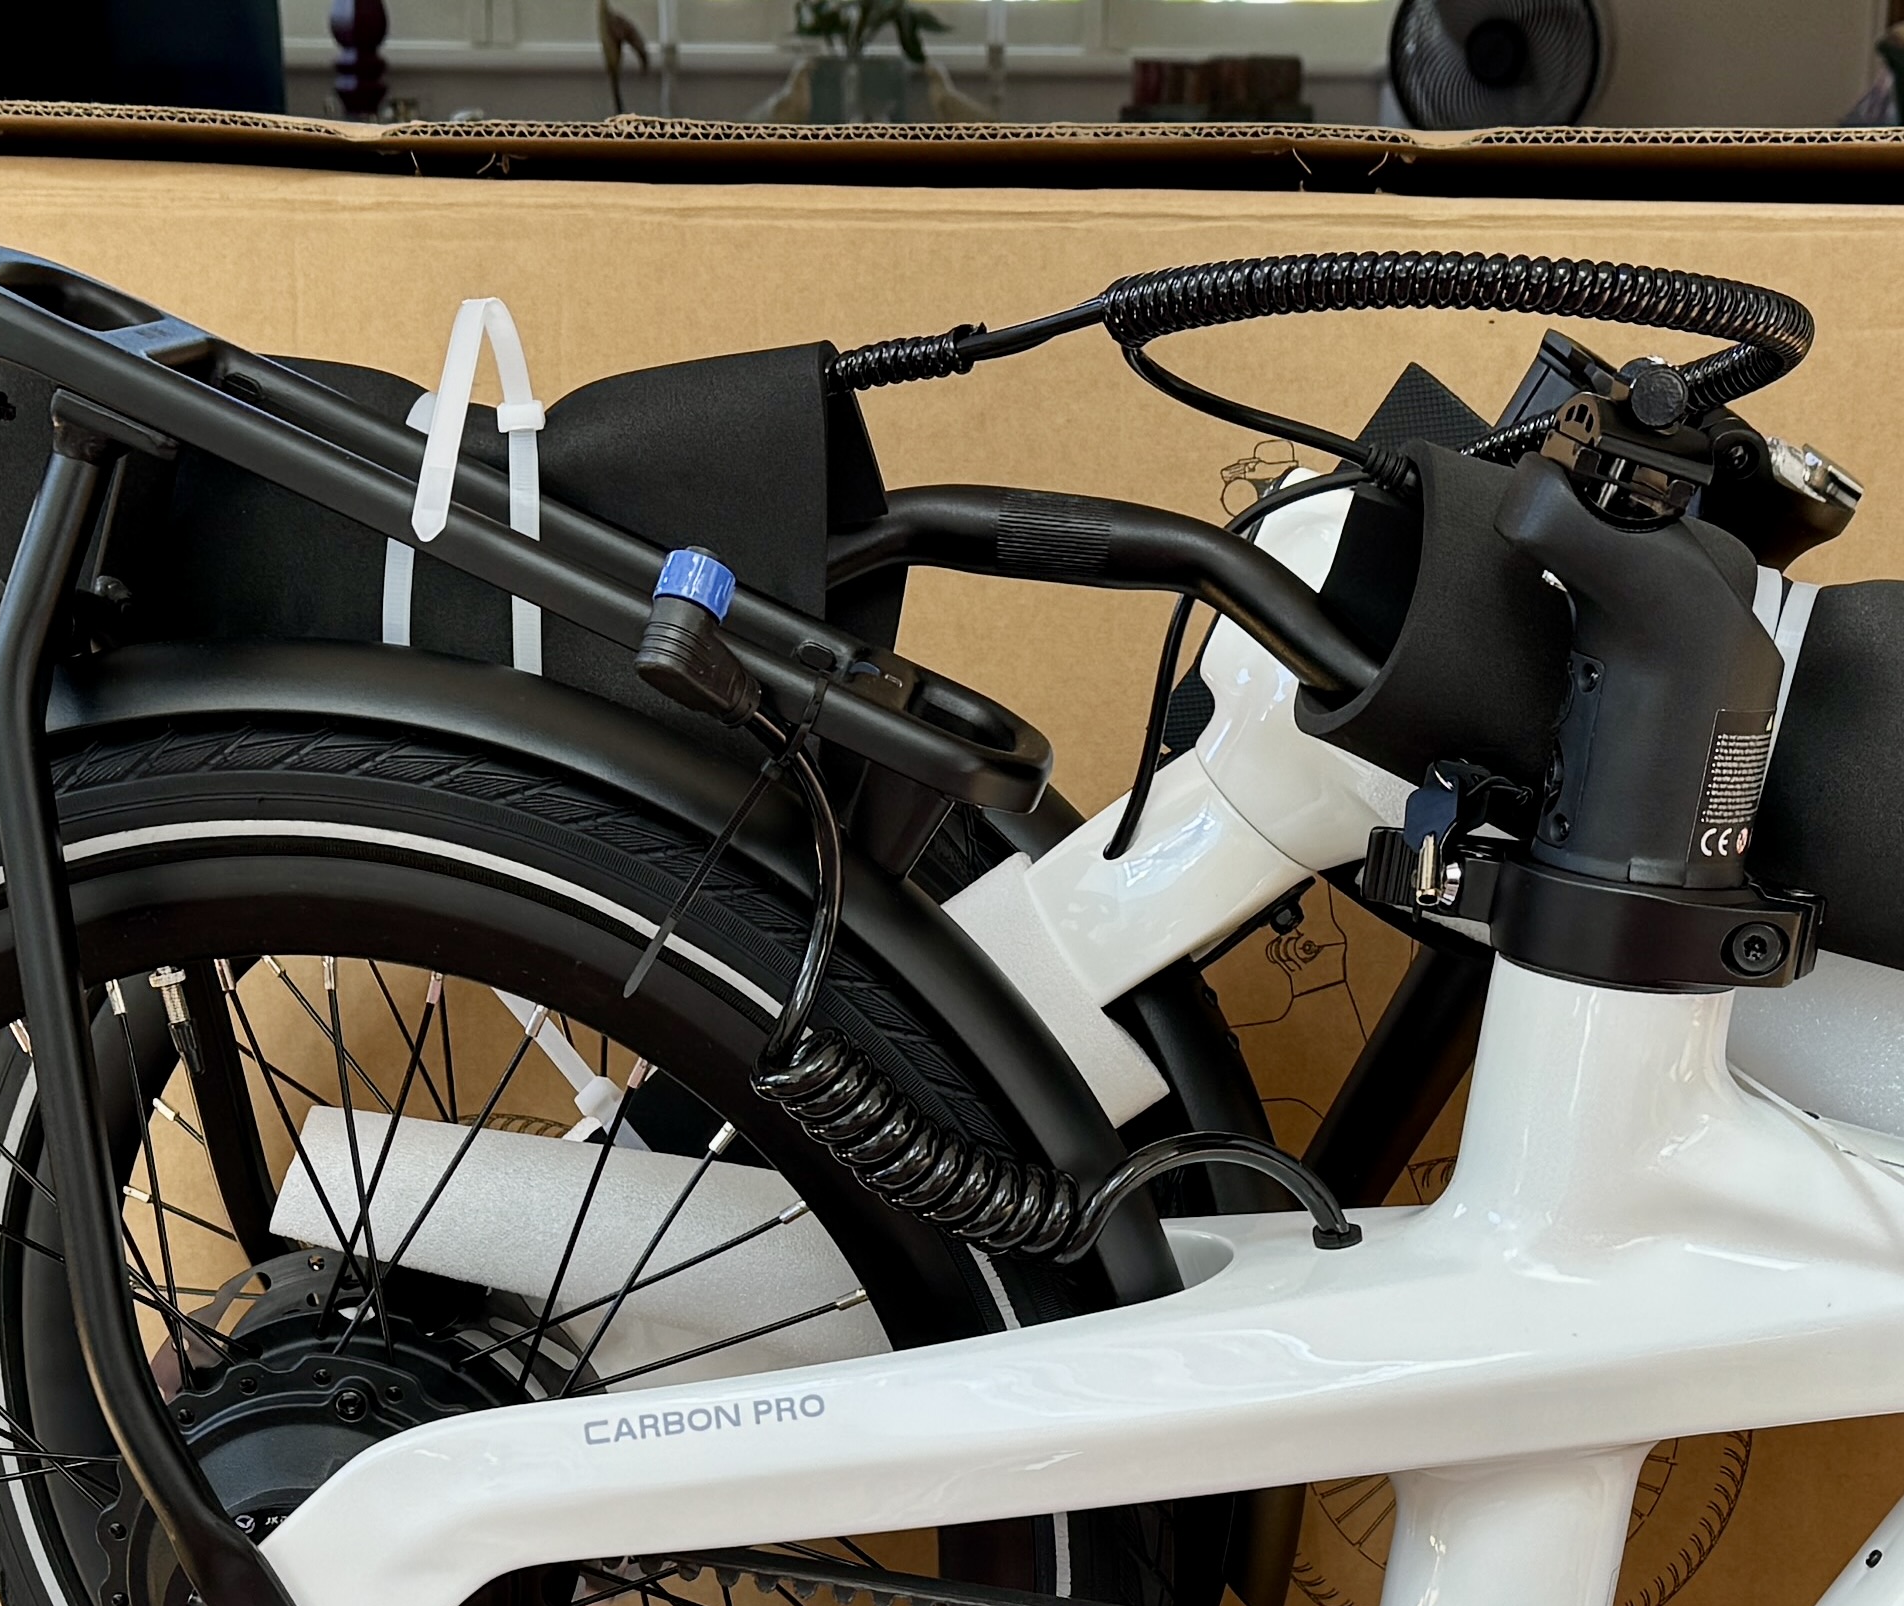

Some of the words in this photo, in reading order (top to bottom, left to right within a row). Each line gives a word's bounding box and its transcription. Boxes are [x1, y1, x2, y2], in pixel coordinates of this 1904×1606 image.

[1700, 827, 1733, 857] CE
[584, 1402, 742, 1446] CARBON
[753, 1394, 826, 1426] PRO
